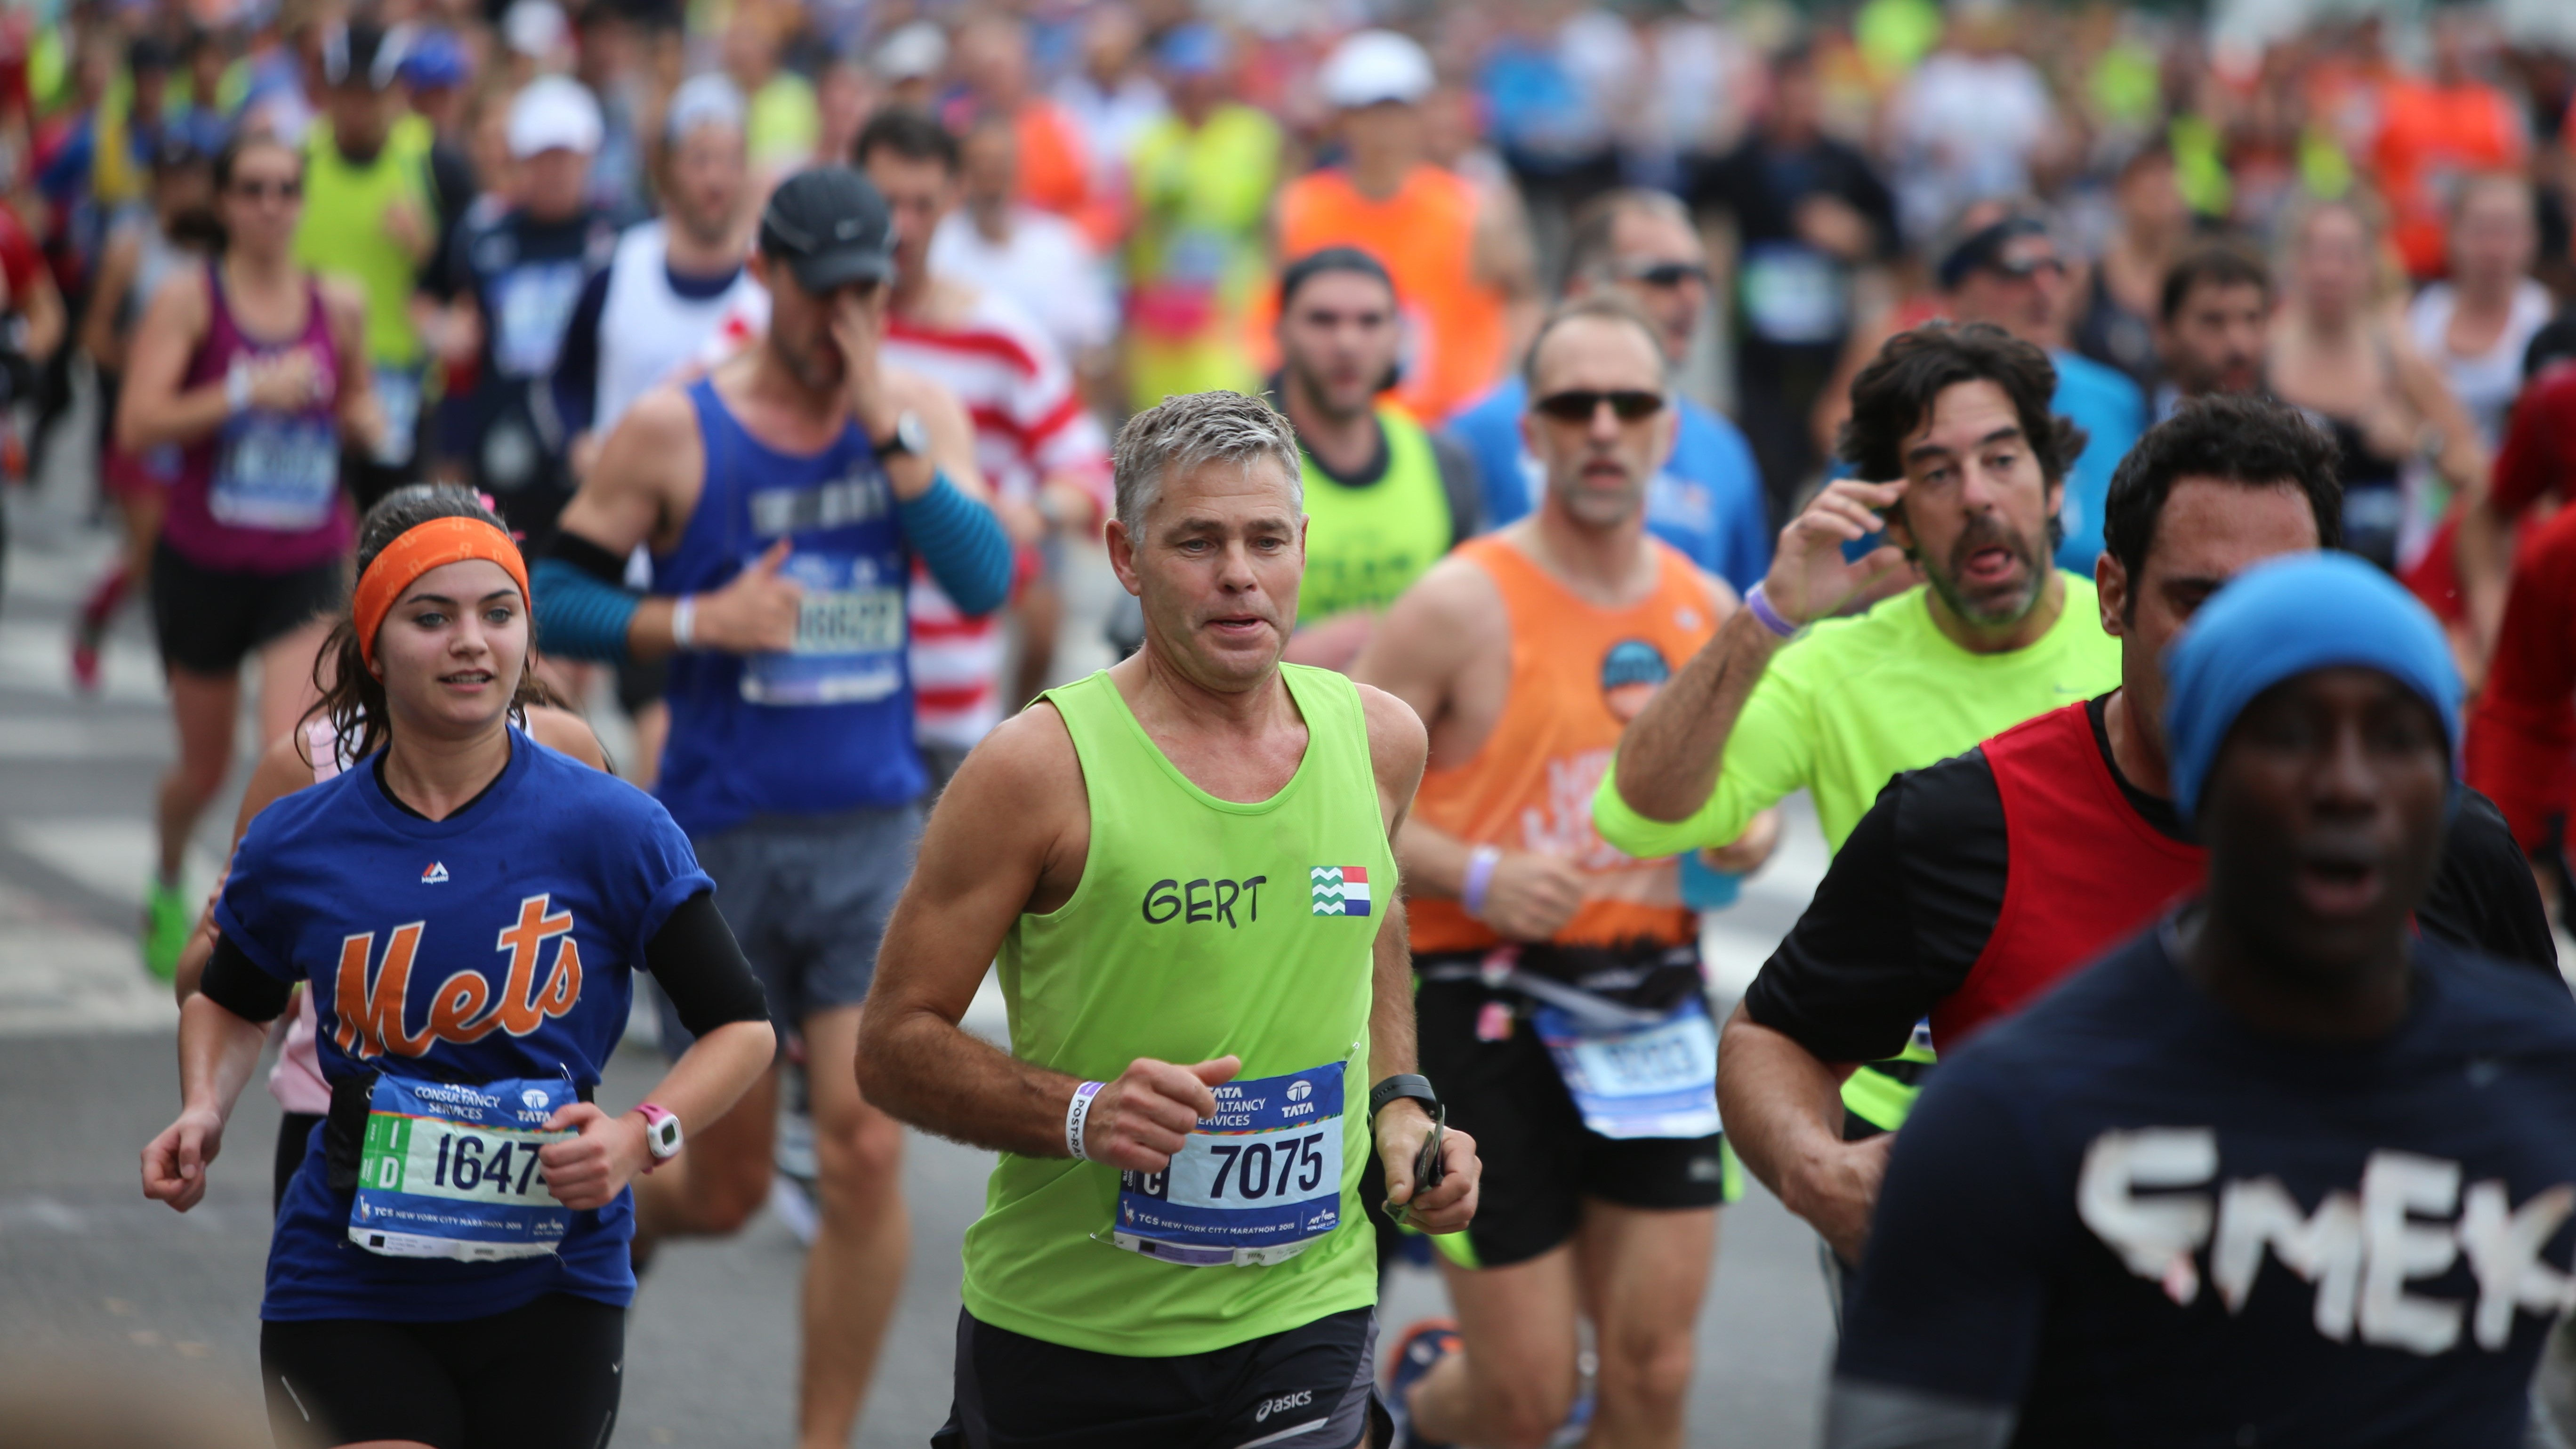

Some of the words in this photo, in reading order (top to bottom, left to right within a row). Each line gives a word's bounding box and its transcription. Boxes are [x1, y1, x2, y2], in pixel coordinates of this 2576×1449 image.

[1142, 876, 1267, 929] GERT
[335, 893, 582, 1059] Mets
[415, 1086, 500, 1107] CONSULTANCY
[428, 1102, 483, 1120] SERVICES
[1198, 1114, 1251, 1127] ERVICES
[1281, 1102, 1314, 1118] TATA
[378, 1156, 400, 1189] D
[435, 1134, 551, 1196] 1647
[1209, 1132, 1323, 1199] 7075
[374, 1206, 394, 1217] TCS
[395, 1210, 416, 1220] NEW
[416, 1212, 438, 1223] YORK
[439, 1215, 458, 1225] CITY
[459, 1217, 504, 1230] MARATHON
[1138, 1214, 1159, 1225] TCS
[1161, 1220, 1182, 1229] NEW
[1183, 1224, 1206, 1233] YORK
[1230, 1225, 1275, 1234] MARATHON
[1279, 1223, 1295, 1231] 2015
[1272, 1390, 1312, 1413] asics
